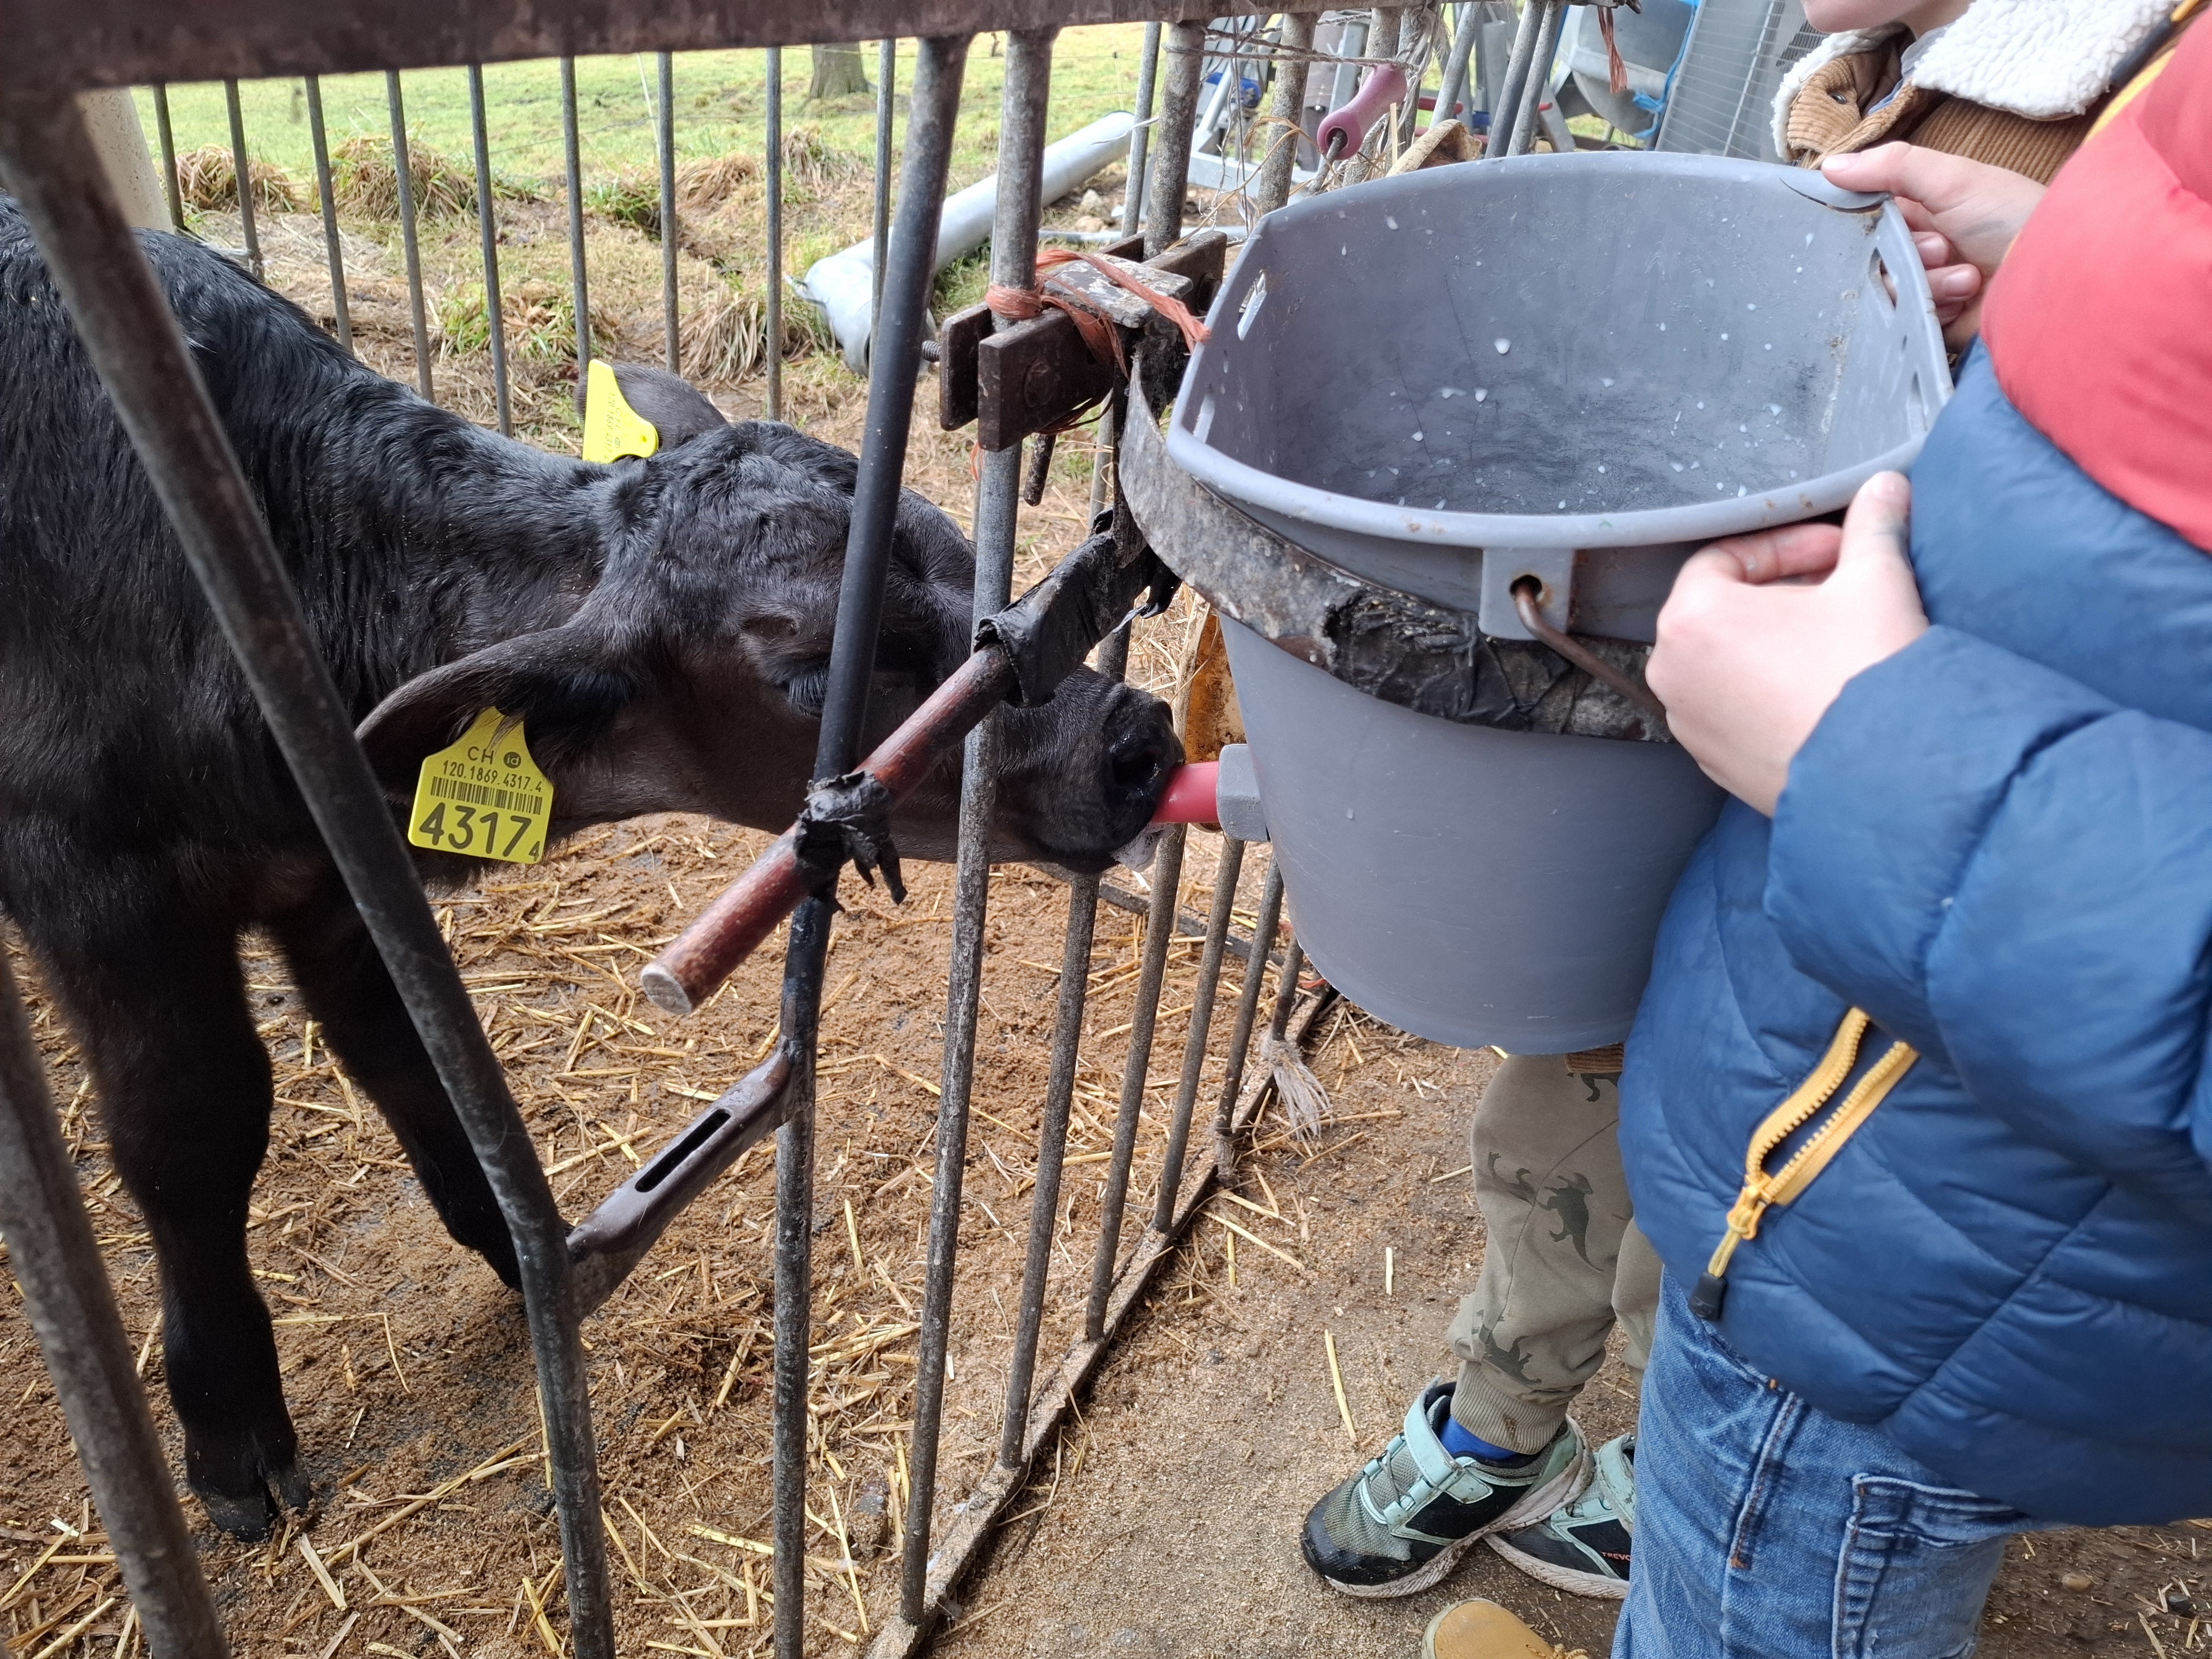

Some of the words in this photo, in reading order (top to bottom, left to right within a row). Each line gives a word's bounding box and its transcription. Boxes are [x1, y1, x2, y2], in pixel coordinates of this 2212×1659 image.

[615, 407, 622, 428] CH
[467, 747, 494, 764] CH
[443, 760, 542, 793] 120.1869.4317.4
[419, 802, 532, 857] 4317
